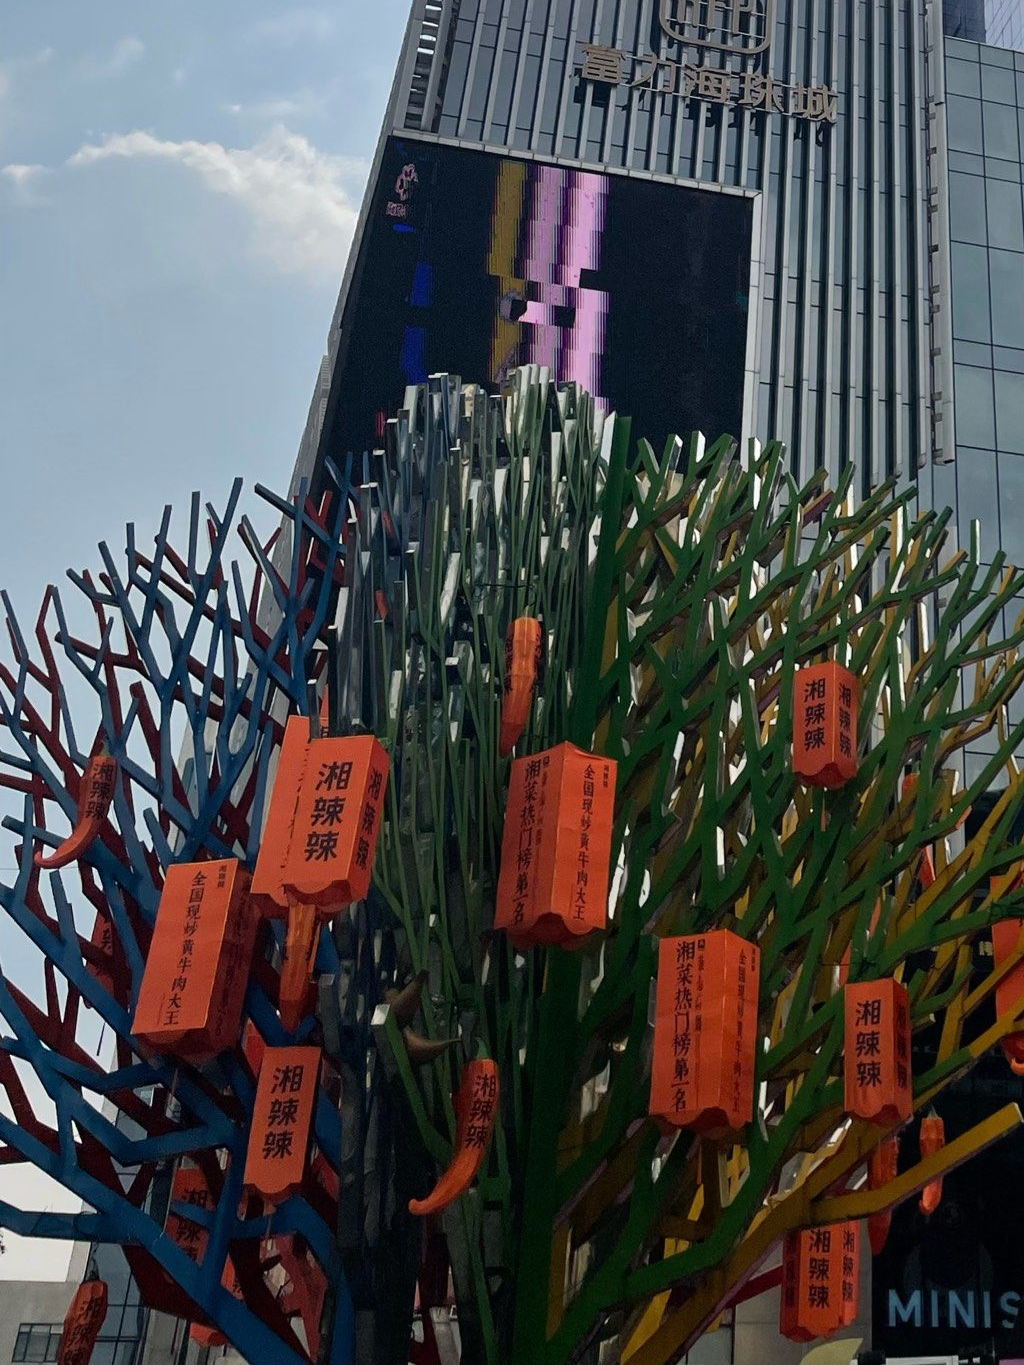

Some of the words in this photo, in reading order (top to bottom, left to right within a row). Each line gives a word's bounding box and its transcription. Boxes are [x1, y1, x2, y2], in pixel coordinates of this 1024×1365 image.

[581, 44, 839, 124] 富力海珠城
[804, 677, 826, 751] 湘辣辣
[838, 681, 852, 756] 湘辣辣
[304, 761, 353, 862] 湘辣辣
[572, 763, 596, 921] 全国现炒黄牛肉大王
[163, 870, 207, 1026] 全国现炒黄牛肉大王
[671, 940, 696, 1113] 湘菜热门榜第一名
[855, 998, 882, 1089] 湘辣辣
[263, 1065, 302, 1160] 湘辣辣
[465, 1074, 496, 1149] 湘辣辣
[808, 1229, 831, 1309] 湘辣辣
